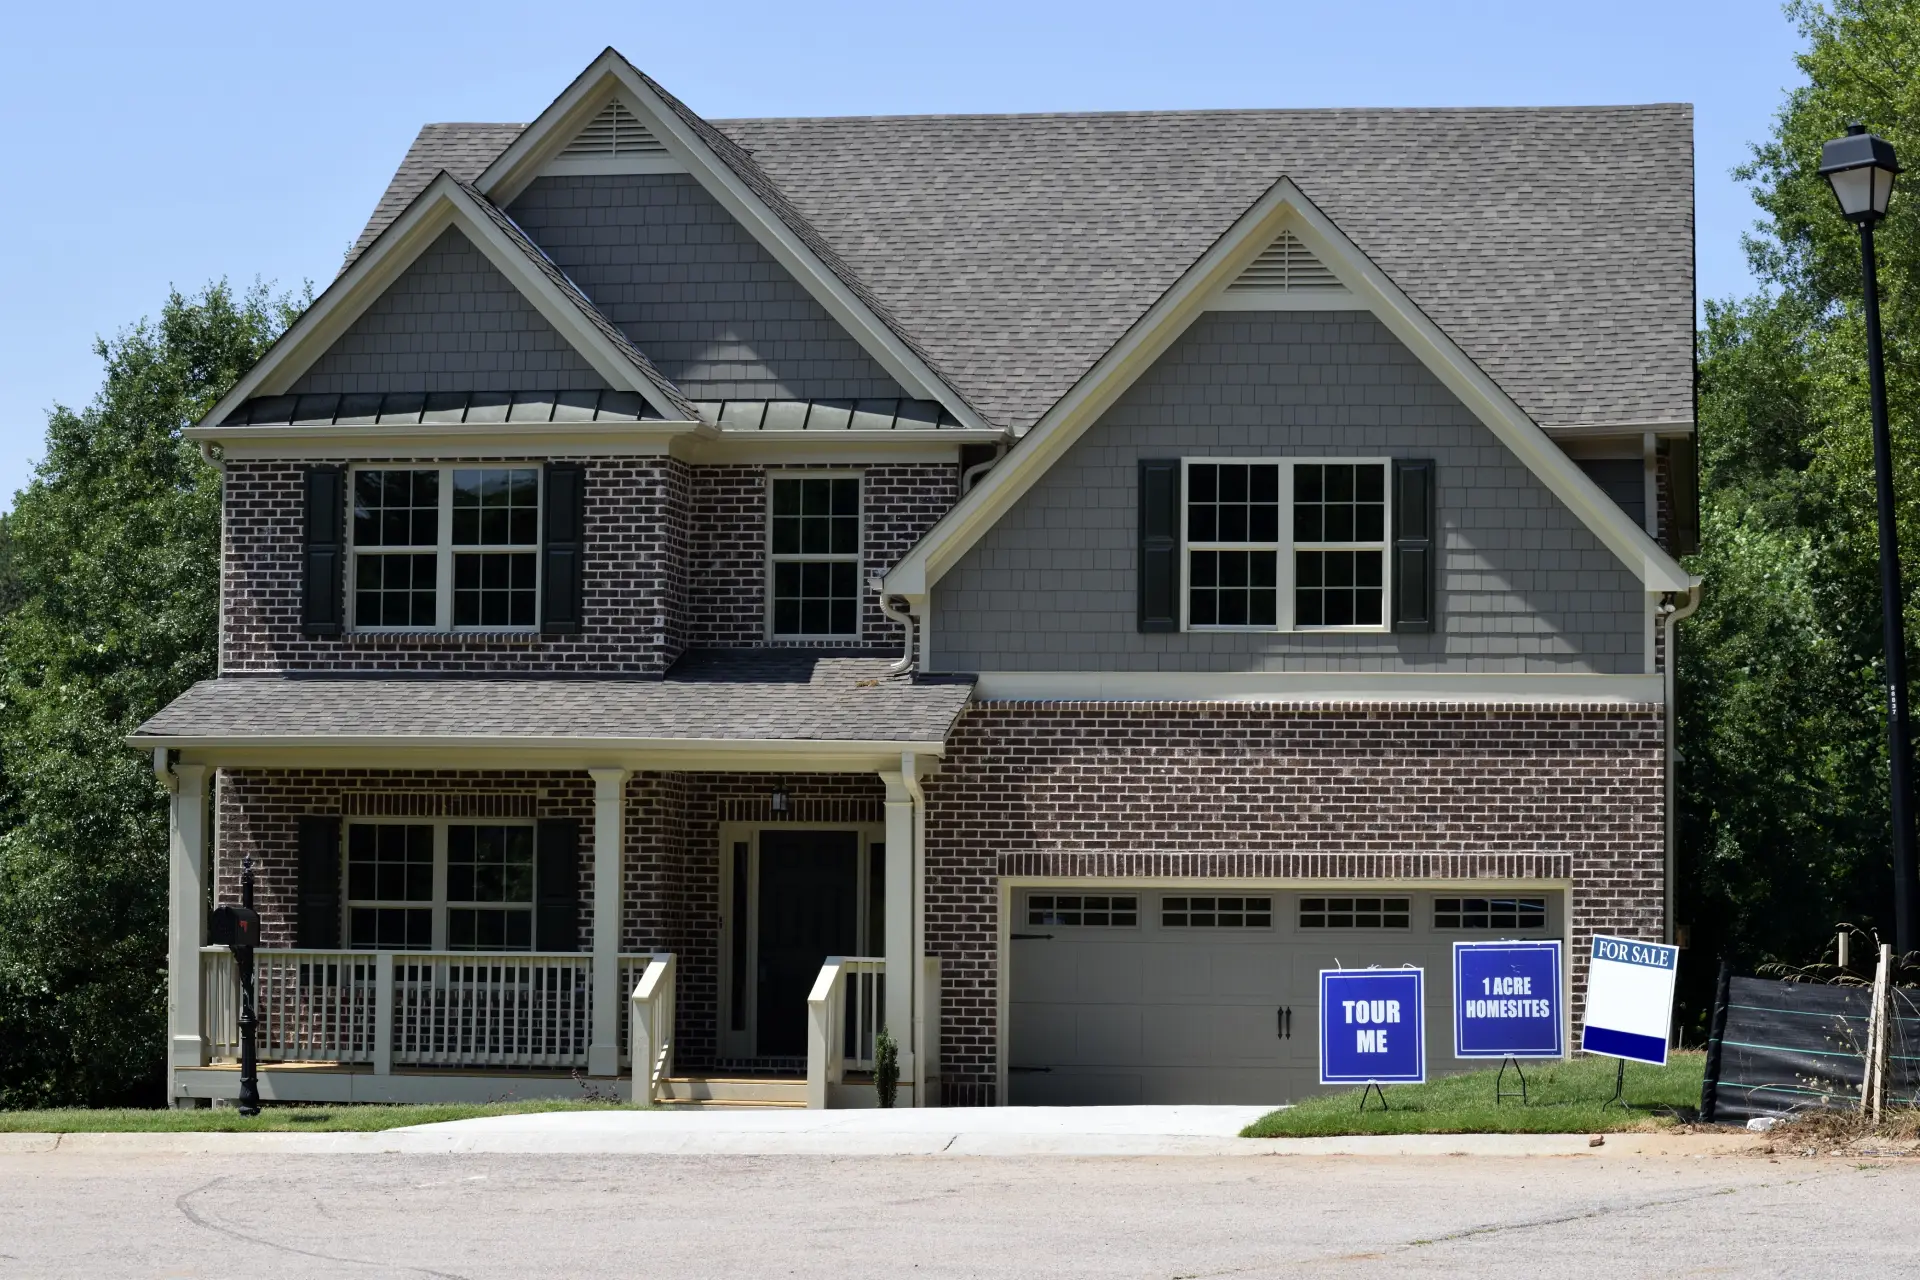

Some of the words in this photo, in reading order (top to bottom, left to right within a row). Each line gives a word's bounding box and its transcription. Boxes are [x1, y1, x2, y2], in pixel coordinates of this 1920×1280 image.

[1599, 940, 1628, 961] FOR
[1631, 945, 1669, 967] SALE
[1482, 977, 1490, 995] 1
[1493, 977, 1531, 995] ACRE
[1343, 1000, 1400, 1024] TOUR
[1466, 999, 1550, 1018] HOMESITES
[1357, 1030, 1388, 1053] ME
